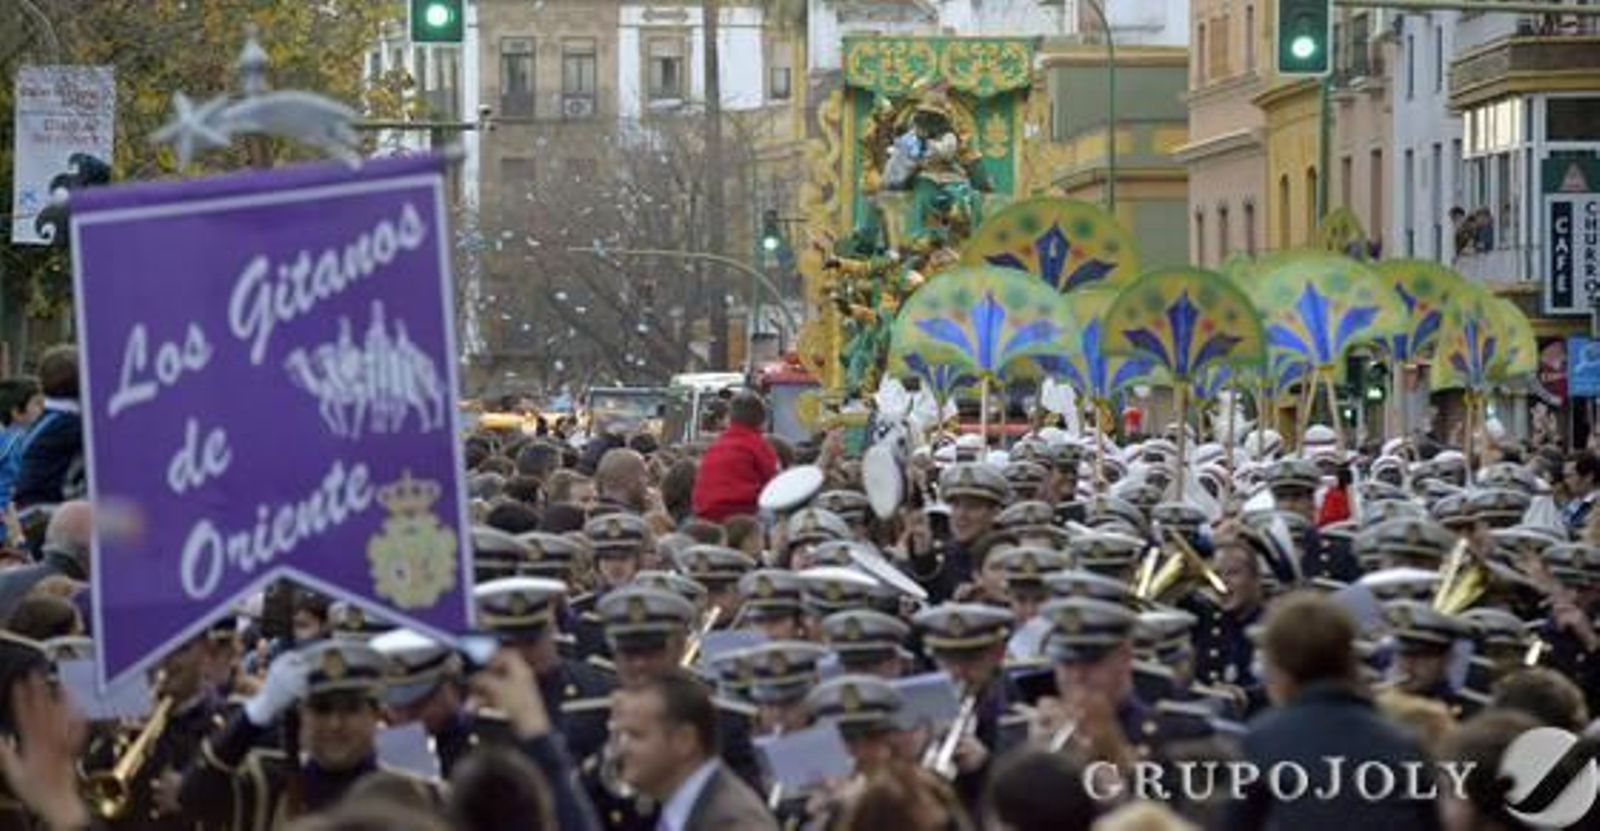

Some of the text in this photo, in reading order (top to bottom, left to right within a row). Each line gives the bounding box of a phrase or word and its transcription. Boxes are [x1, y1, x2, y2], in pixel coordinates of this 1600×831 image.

[108, 203, 427, 417] Los Gitanos
[167, 418, 232, 494] de
[181, 463, 374, 599] Oriente
